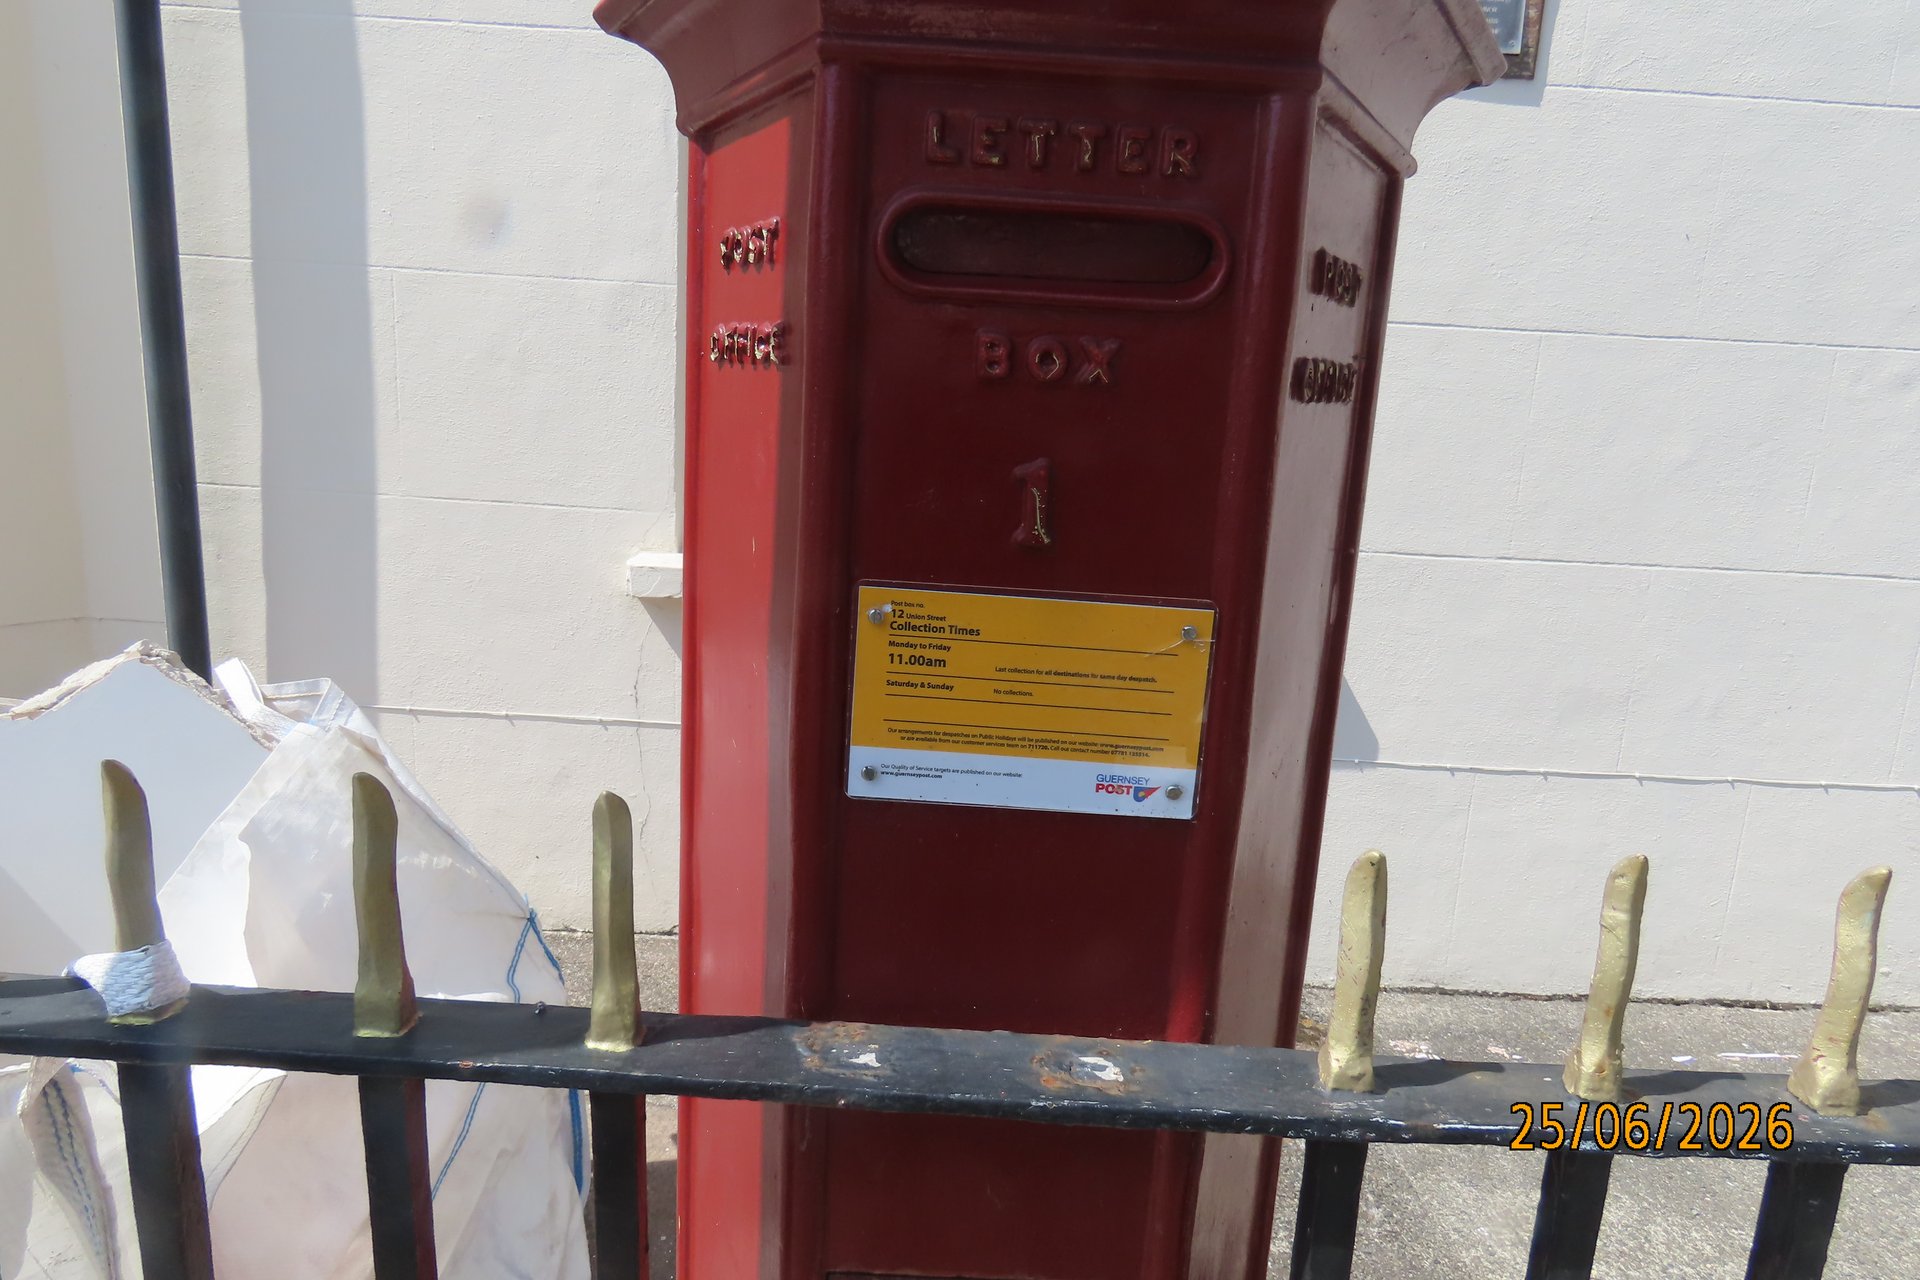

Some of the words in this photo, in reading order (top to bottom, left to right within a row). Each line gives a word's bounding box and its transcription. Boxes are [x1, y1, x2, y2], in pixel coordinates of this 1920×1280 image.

[926, 110, 1200, 177] LETTER
[720, 216, 780, 270] POST
[976, 328, 1121, 385] BOX
[1010, 458, 1051, 547] 1
[891, 609, 904, 619] 12
[906, 613, 926, 621] Union
[926, 614, 946, 622] Street
[890, 621, 946, 634] Collection
[948, 625, 981, 636] Times
[888, 640, 918, 650] Monday
[928, 644, 951, 652] Friday
[888, 653, 947, 668] 11.00am
[1008, 667, 1035, 675] collection
[1053, 670, 1089, 678] destinations
[1116, 674, 1128, 682] day
[1128, 675, 1157, 683] despatch.
[886, 680, 919, 689] Saturday
[927, 682, 954, 692] Sunday
[1002, 689, 1034, 697] collections.
[898, 728, 933, 736] arrangements
[942, 731, 970, 739] despatches
[995, 734, 1016, 742] Holidays
[1034, 737, 1059, 745] published
[880, 771, 943, 779] www.guernseypost.com
[960, 768, 985, 776] published
[1096, 774, 1150, 786] GUERNSEY
[1095, 783, 1133, 795] POST
